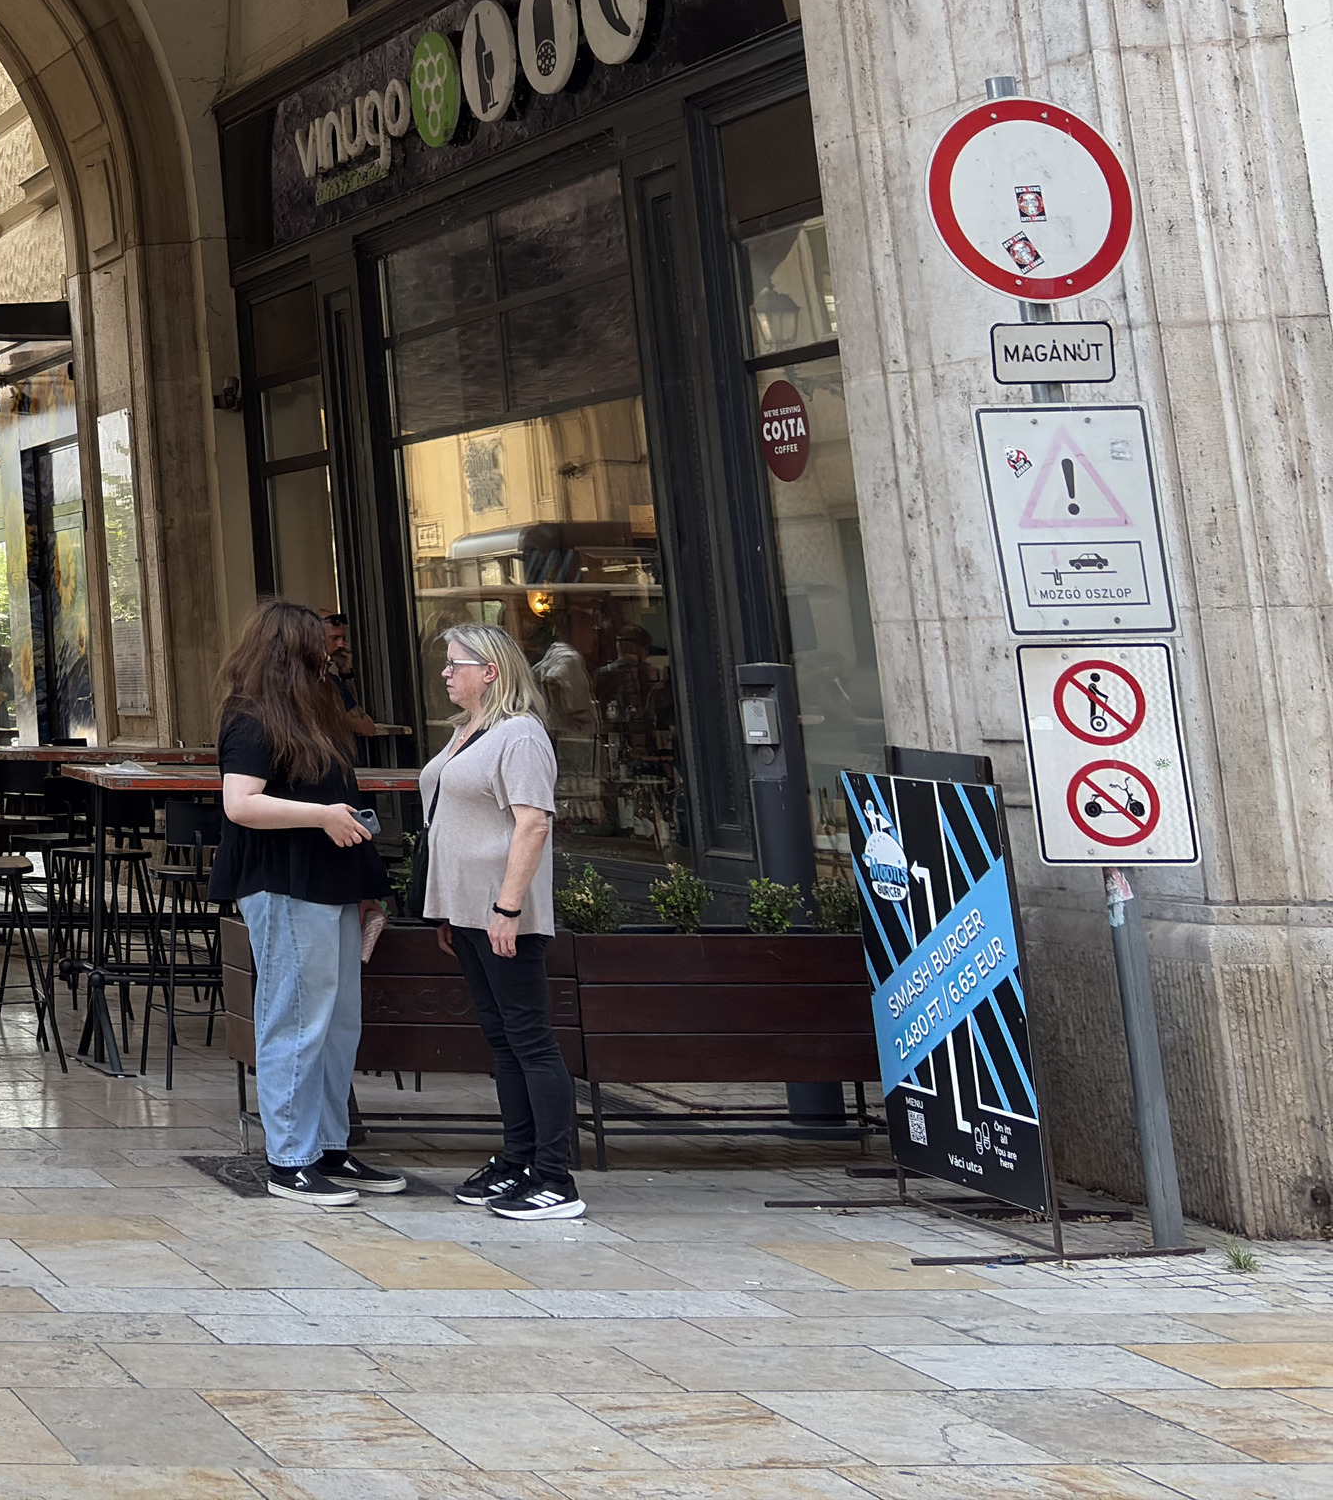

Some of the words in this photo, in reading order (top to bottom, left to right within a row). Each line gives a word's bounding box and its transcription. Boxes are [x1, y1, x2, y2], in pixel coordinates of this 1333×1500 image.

[295, 78, 411, 178] vinugo
[1003, 338, 1103, 363] MAGÁNÚT
[763, 408, 780, 418] WE'RE
[779, 404, 802, 417] SERVING
[762, 416, 806, 442] COSTA
[774, 443, 798, 455] COFFEE
[1039, 587, 1081, 600] MOZGÓ
[1085, 587, 1132, 599] OSZLOP
[888, 961, 933, 1019] SMASH
[930, 908, 986, 976] BURGER
[894, 1014, 930, 1061] 2.480
[925, 996, 944, 1028] FT
[948, 964, 978, 1004] 6.65
[974, 936, 1007, 978] EUR
[905, 1096, 924, 1110] MENU
[993, 1145, 1006, 1157] You
[1007, 1151, 1017, 1161] are
[948, 1153, 965, 1169] Váci
[965, 1159, 984, 1176] utca
[1000, 1158, 1014, 1171] here
